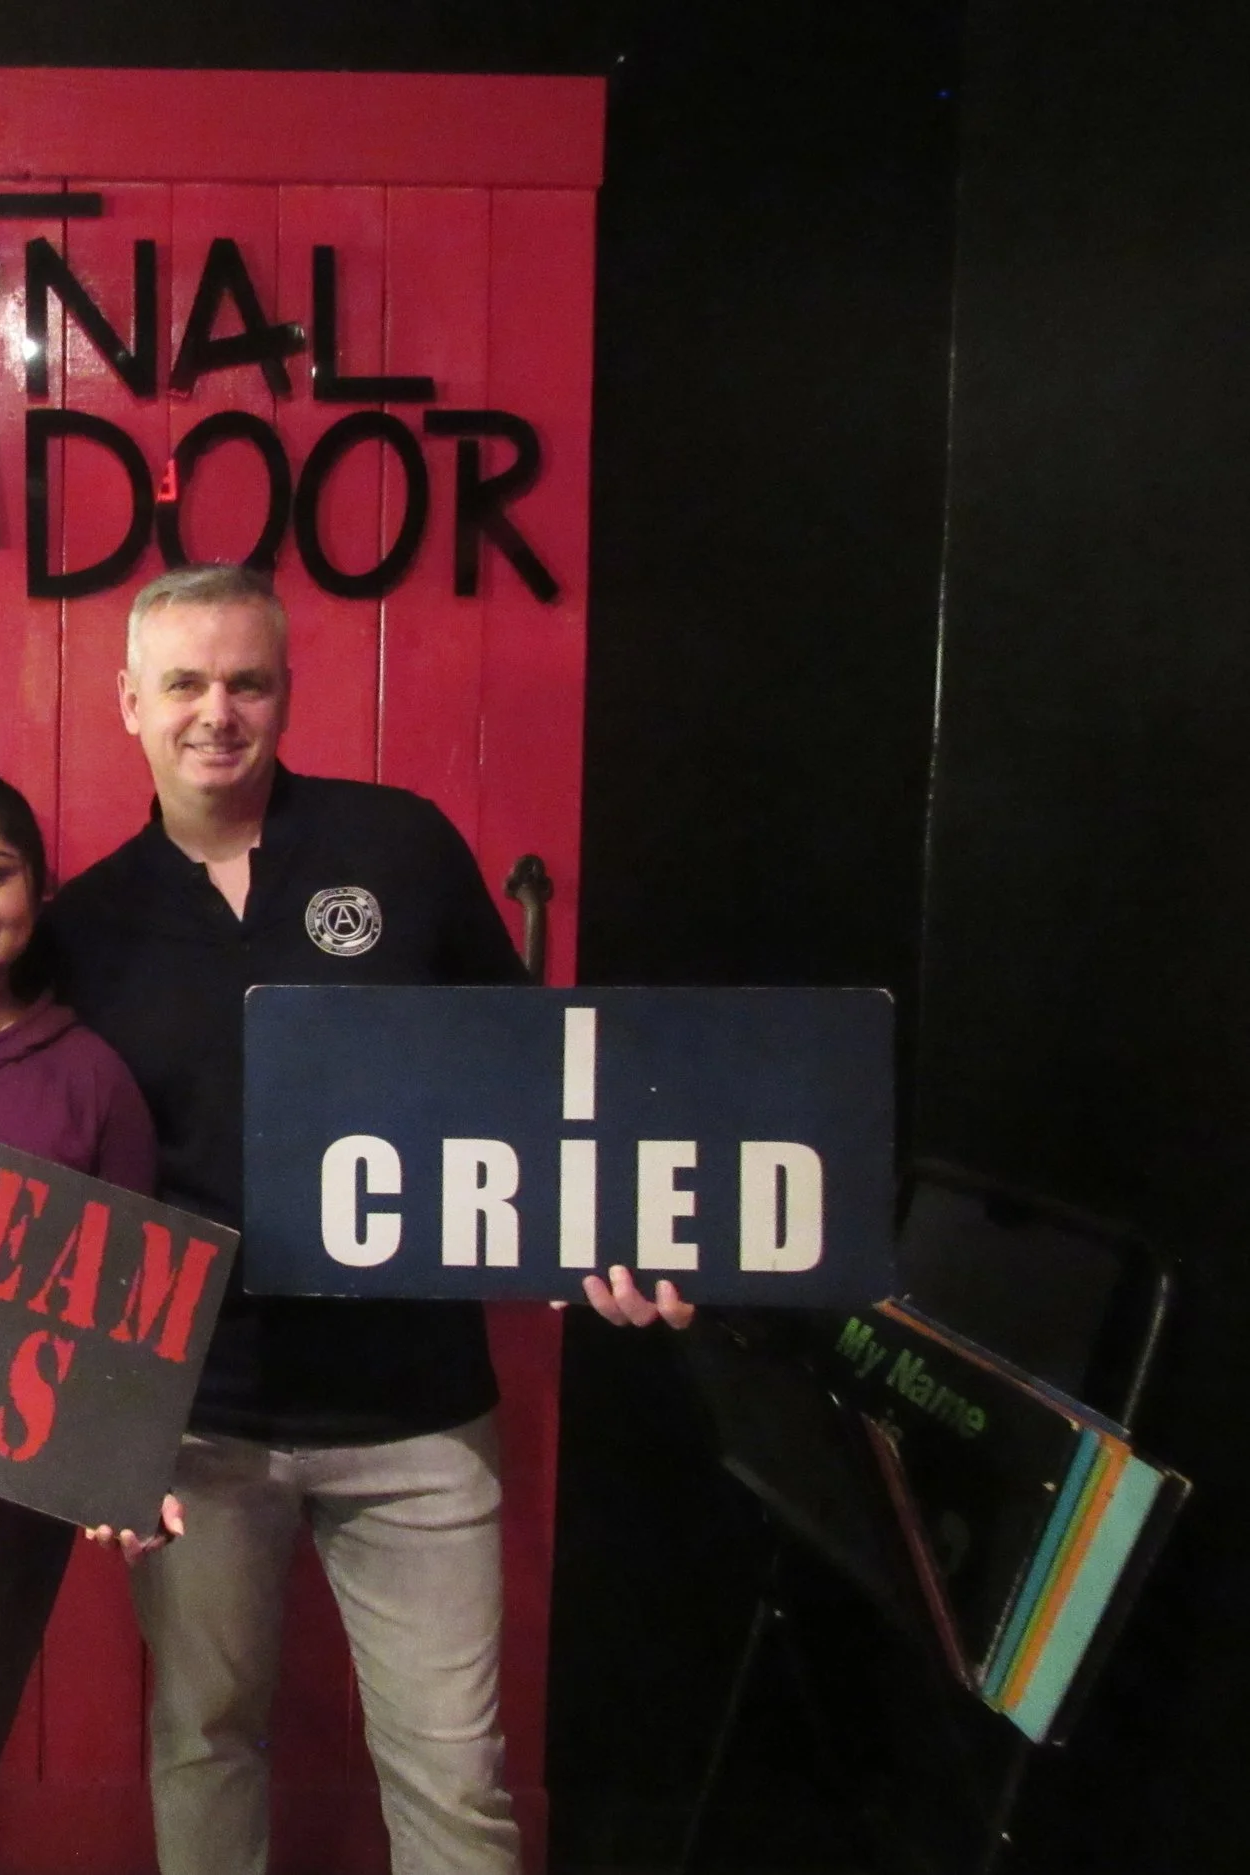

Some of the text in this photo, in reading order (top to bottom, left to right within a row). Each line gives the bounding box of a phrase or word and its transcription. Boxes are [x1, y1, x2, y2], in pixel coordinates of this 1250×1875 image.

[27, 409, 561, 604] DOOR
[562, 1007, 597, 1120] I
[320, 1134, 823, 1273] CRIED
[835, 1316, 887, 1379] My
[886, 1348, 987, 1438] Name
